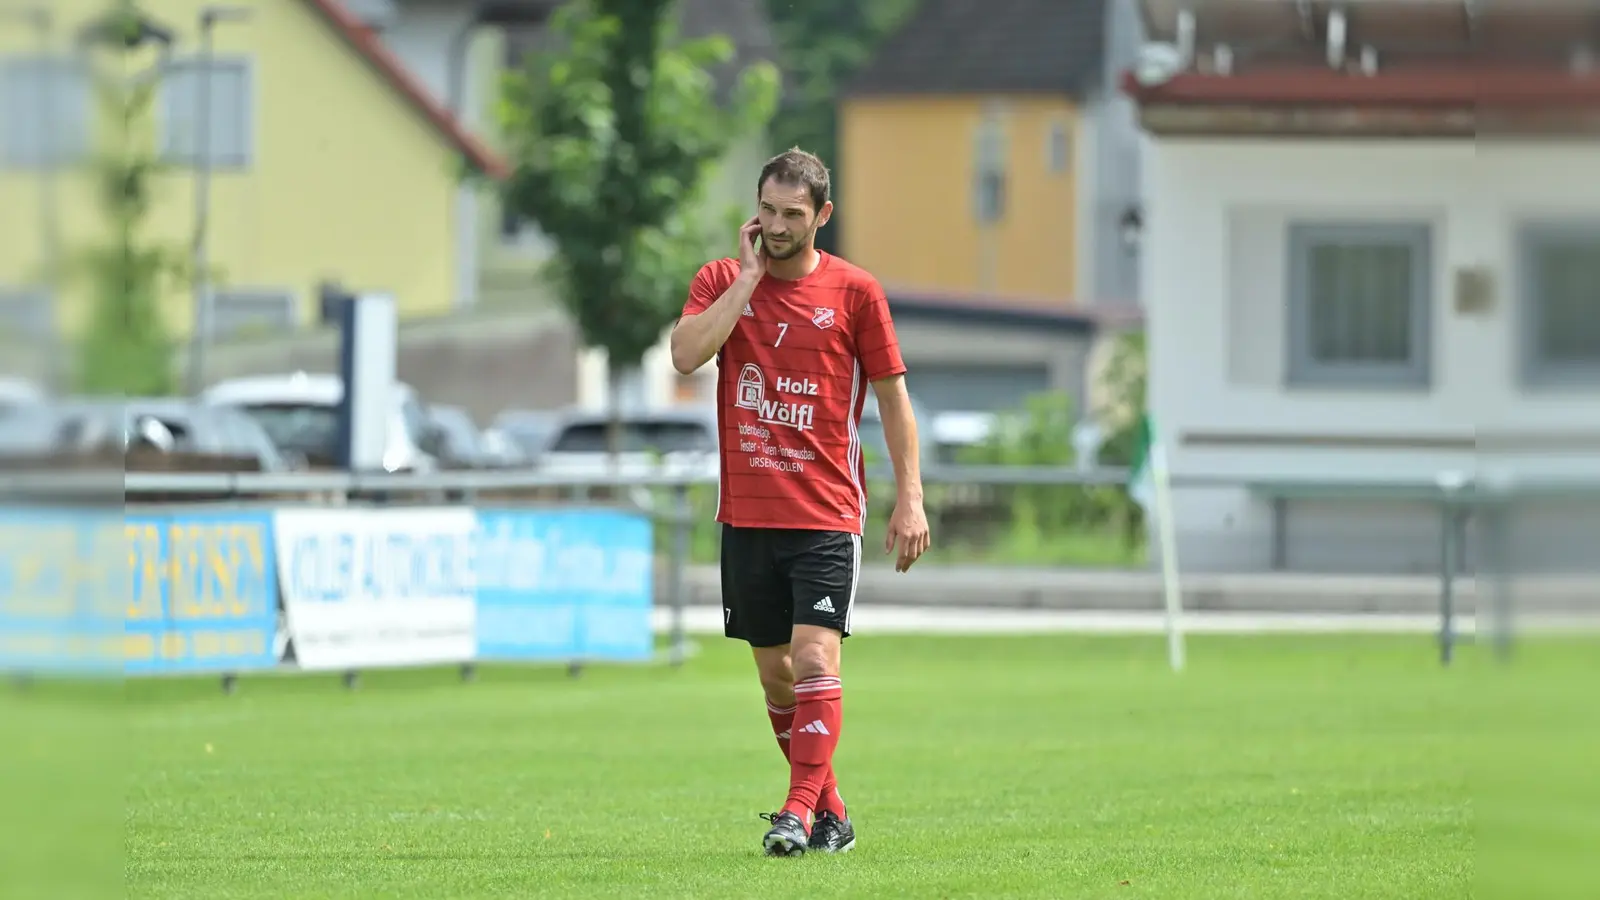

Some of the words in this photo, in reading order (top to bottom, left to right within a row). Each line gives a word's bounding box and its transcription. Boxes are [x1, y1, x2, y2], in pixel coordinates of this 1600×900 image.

[774, 323, 788, 348] 7
[776, 376, 818, 396] Holz
[756, 399, 814, 431] Wölfl
[761, 442, 777, 456] Türen
[749, 457, 804, 473] URSENSOLLEN
[725, 608, 731, 624] 7
[813, 604, 835, 613] adidas
